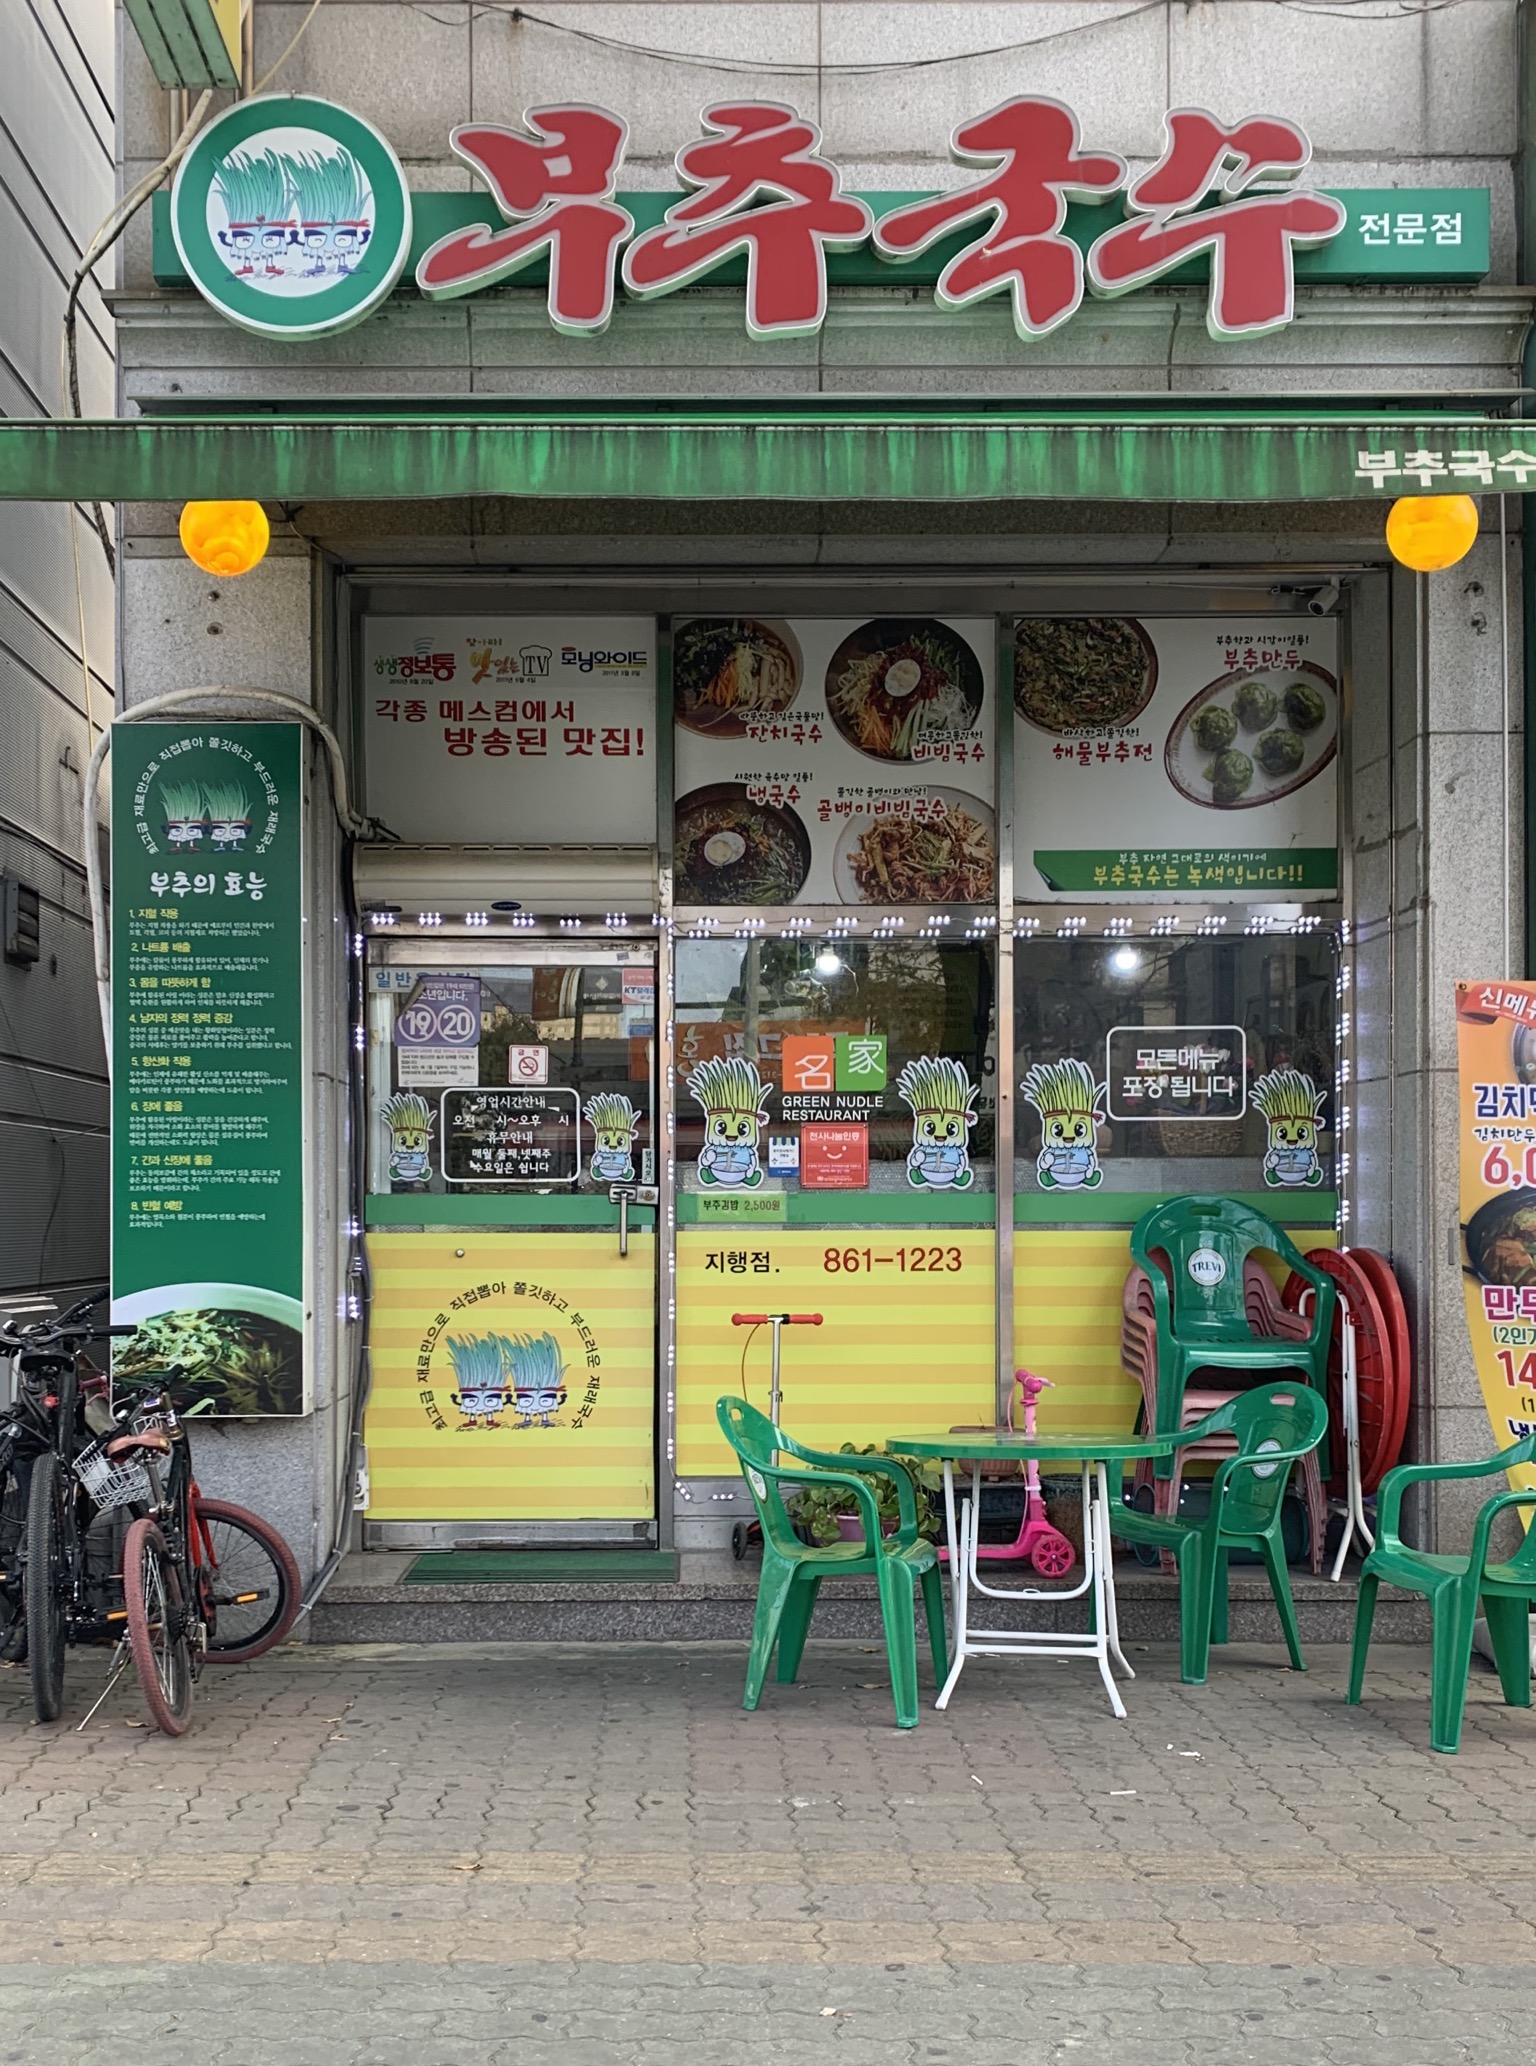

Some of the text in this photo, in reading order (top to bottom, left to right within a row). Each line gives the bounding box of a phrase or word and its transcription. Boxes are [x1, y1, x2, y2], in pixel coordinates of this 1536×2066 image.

[415, 96, 1347, 342] 부추국수
[1358, 212, 1462, 245] 전문점
[1355, 450, 1536, 488] 부추국수
[561, 647, 647, 673] 모닝와이드
[1224, 647, 1301, 670] 부추만두
[376, 700, 575, 722] 각종 메스컴에서
[444, 728, 644, 756] 방송된 맛집!
[748, 724, 823, 746] 잔치국수
[913, 742, 985, 764] 비빔국수
[1053, 740, 1153, 766] 해물부추전
[749, 784, 801, 806] 냉국수
[817, 799, 946, 822] 골뱅이비빔국수
[1118, 851, 1267, 865] 부추 자연 그대로의 색이기에
[150, 871, 267, 901] 부추의 효능
[1093, 863, 1304, 888] 부추국수는 녹색입니다!!
[417, 990, 469, 1002] 소년입니다.
[443, 1011, 471, 1036] 20
[794, 1038, 884, 1090] 名家
[1136, 1049, 1220, 1070] 모든메뉴
[1122, 1075, 1235, 1099] 포장 됩니다
[476, 1095, 546, 1109] 영업시간안내
[782, 1095, 884, 1108] GREEN NUDLE
[1474, 1085, 1536, 1118] 김치
[452, 1114, 475, 1128] 오전
[558, 1114, 569, 1127] 시
[782, 1109, 870, 1121] RESTAURANT
[487, 1131, 533, 1144] 휴무안내
[141, 1155, 160, 1166] 간과
[471, 1148, 492, 1160] 매월
[472, 1162, 550, 1174] 수요일은 쉽니다
[744, 1199, 781, 1212] 2,500원
[705, 1247, 963, 1274] 지행점. 861-1223
[1192, 1261, 1222, 1273] TREVI
[416, 1313, 451, 1383] 재료만으로
[449, 1281, 507, 1311] 직접뽑아
[570, 1312, 601, 1369] 부드러운
